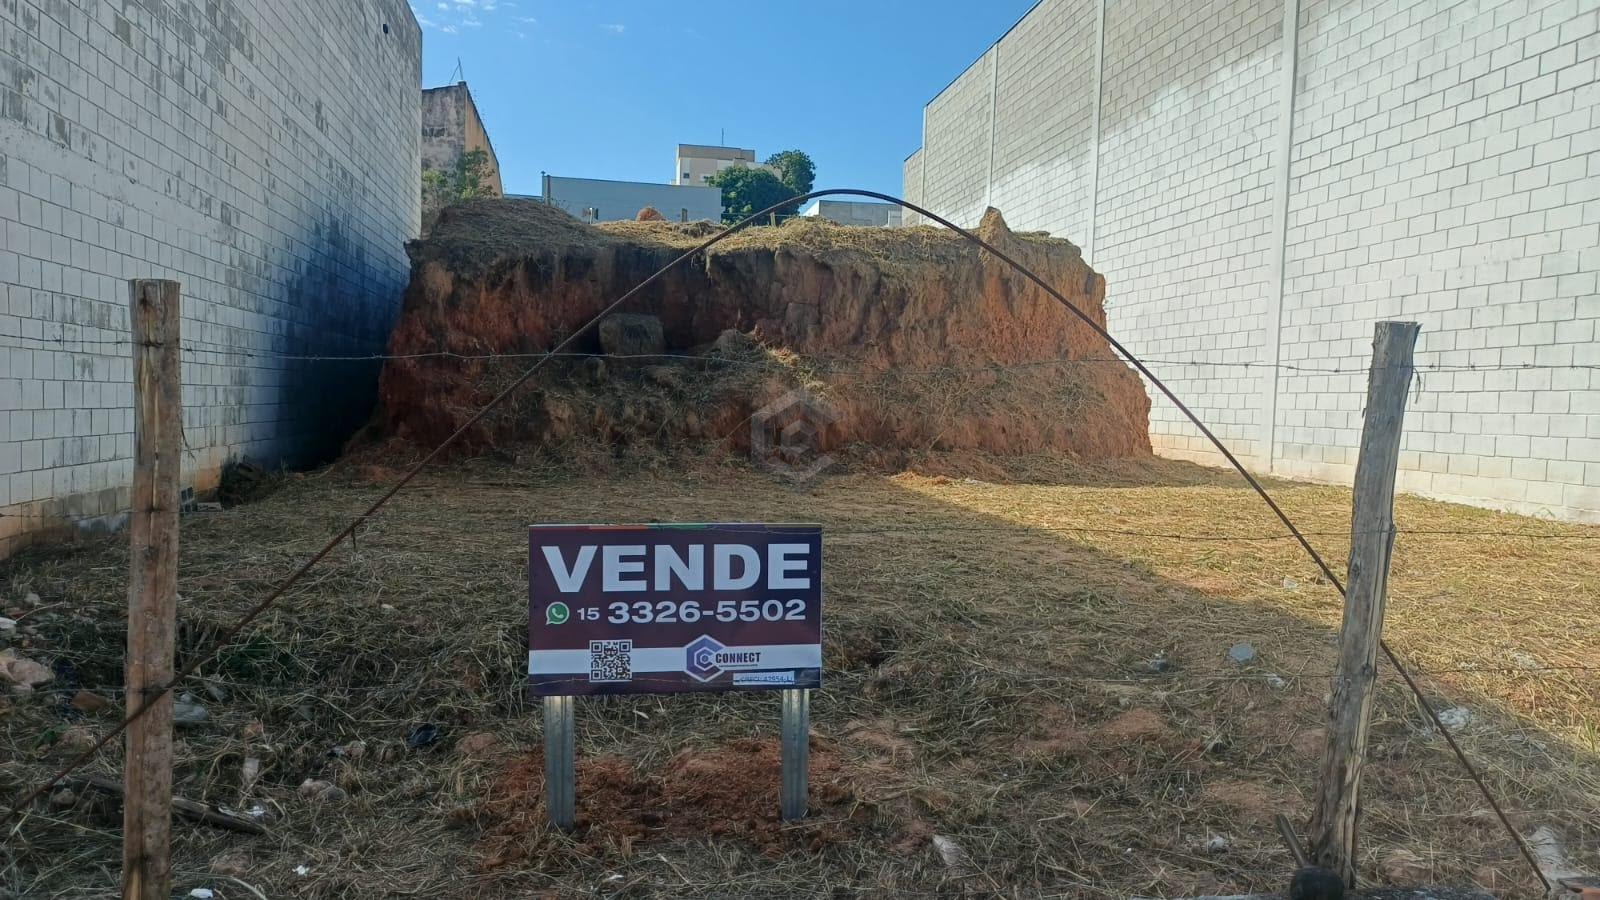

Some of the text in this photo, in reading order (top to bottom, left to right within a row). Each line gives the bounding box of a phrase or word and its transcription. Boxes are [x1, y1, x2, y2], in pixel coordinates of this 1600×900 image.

[541, 543, 810, 592] VENDE
[576, 599, 806, 624] 15 3326-5502
[715, 652, 761, 663] CONNECT
